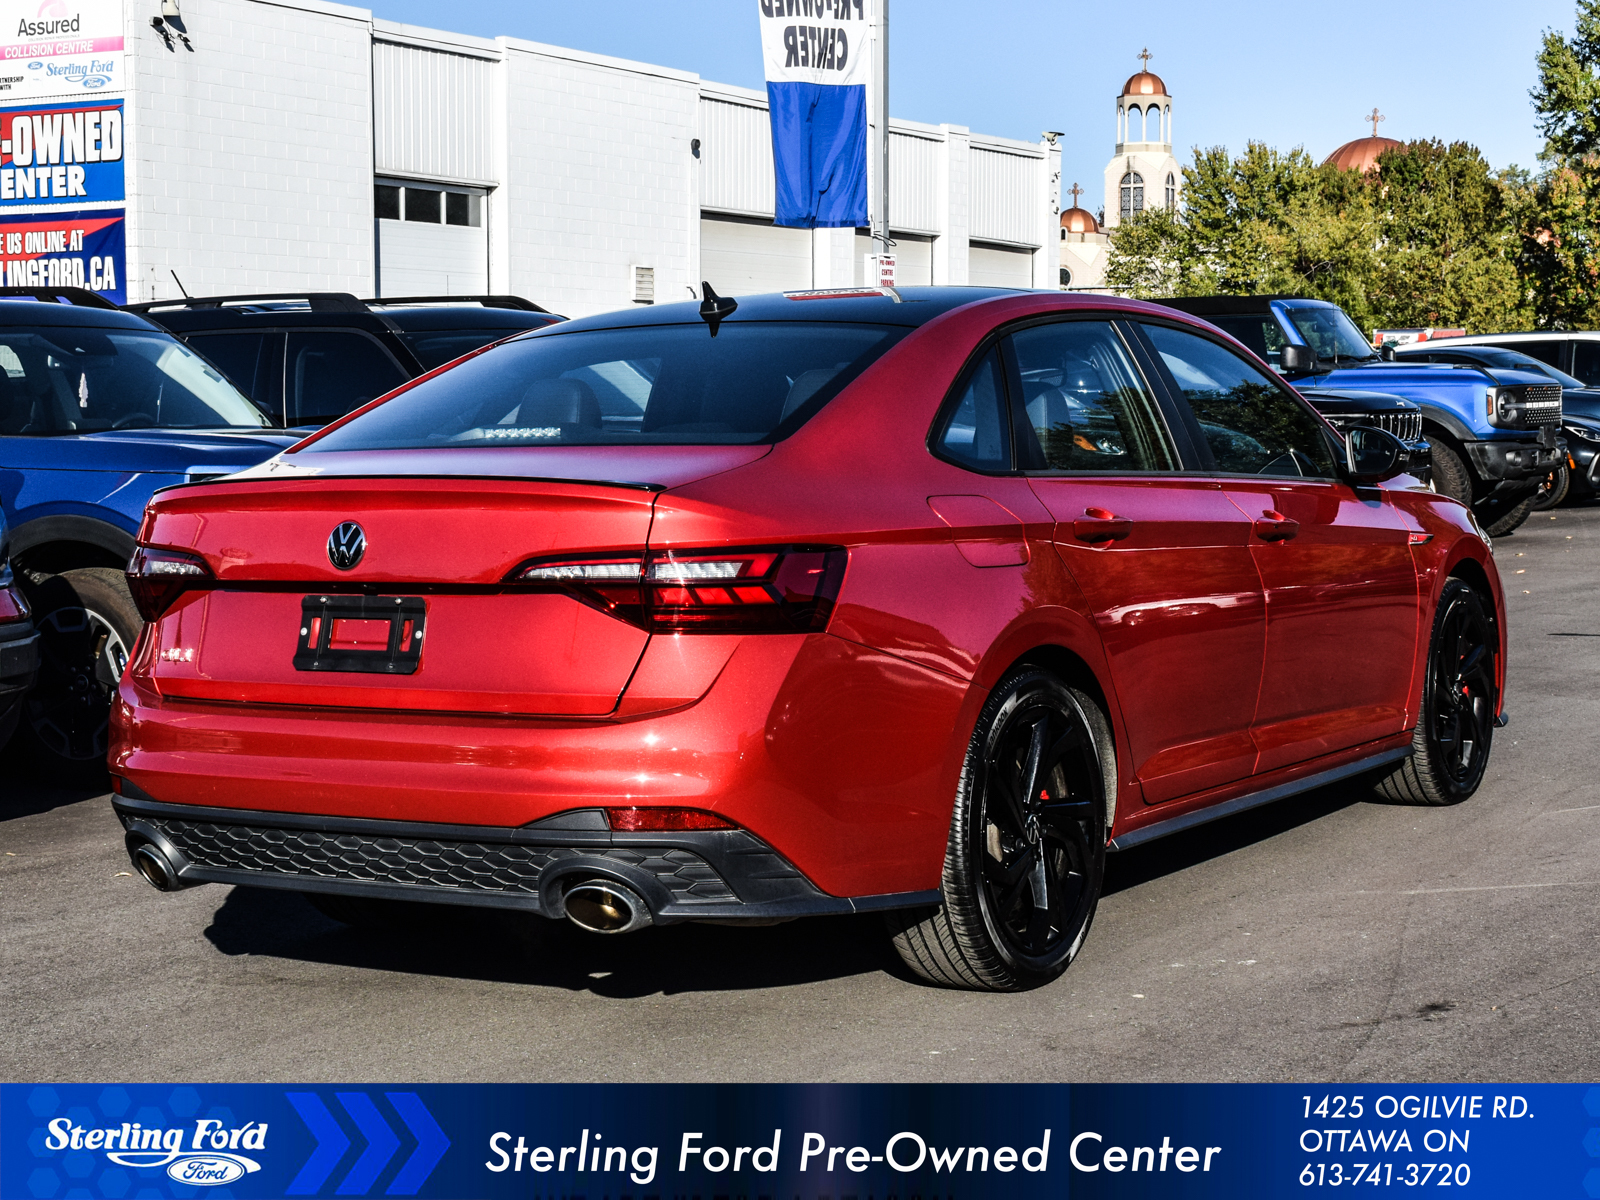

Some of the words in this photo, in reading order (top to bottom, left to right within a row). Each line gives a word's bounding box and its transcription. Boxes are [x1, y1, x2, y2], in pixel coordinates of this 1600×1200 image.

[17, 13, 80, 37] Assured
[5, 43, 55, 59] COLLISION
[56, 40, 94, 54] CENTRE
[46, 62, 88, 78] Sterling
[90, 60, 114, 74] Ford
[0, 109, 123, 168] -OWNED
[6, 232, 22, 254] US
[25, 230, 67, 253] ONLINE
[69, 229, 84, 252] AT
